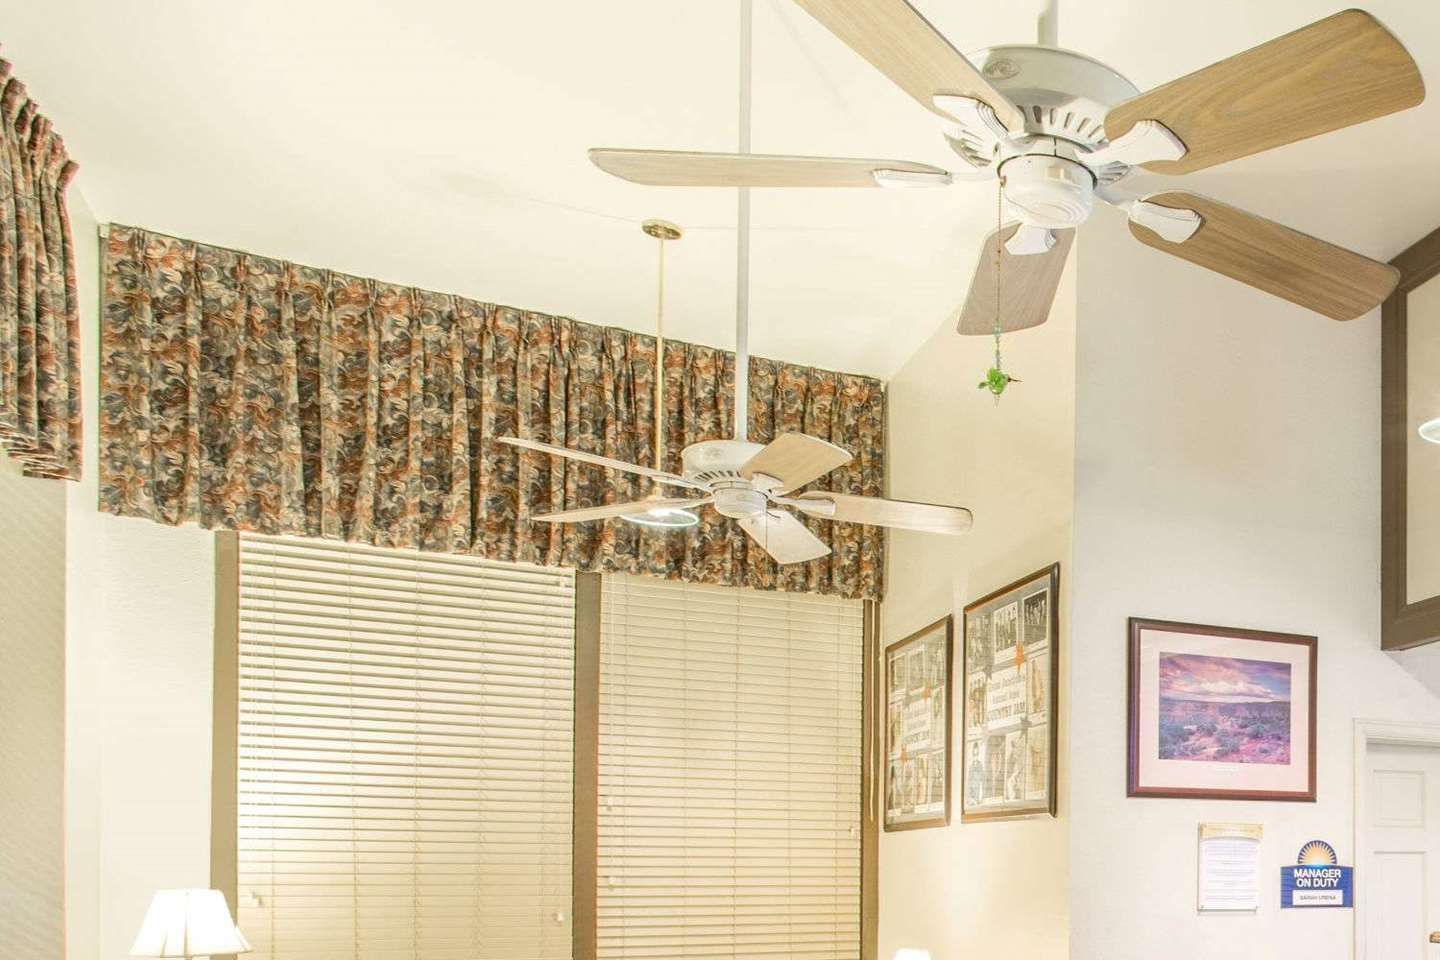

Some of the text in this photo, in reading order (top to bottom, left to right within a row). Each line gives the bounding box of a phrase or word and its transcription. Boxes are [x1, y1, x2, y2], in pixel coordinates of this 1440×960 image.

[1293, 868, 1341, 878] MANAGER
[1296, 878, 1339, 887] ON DUTY
